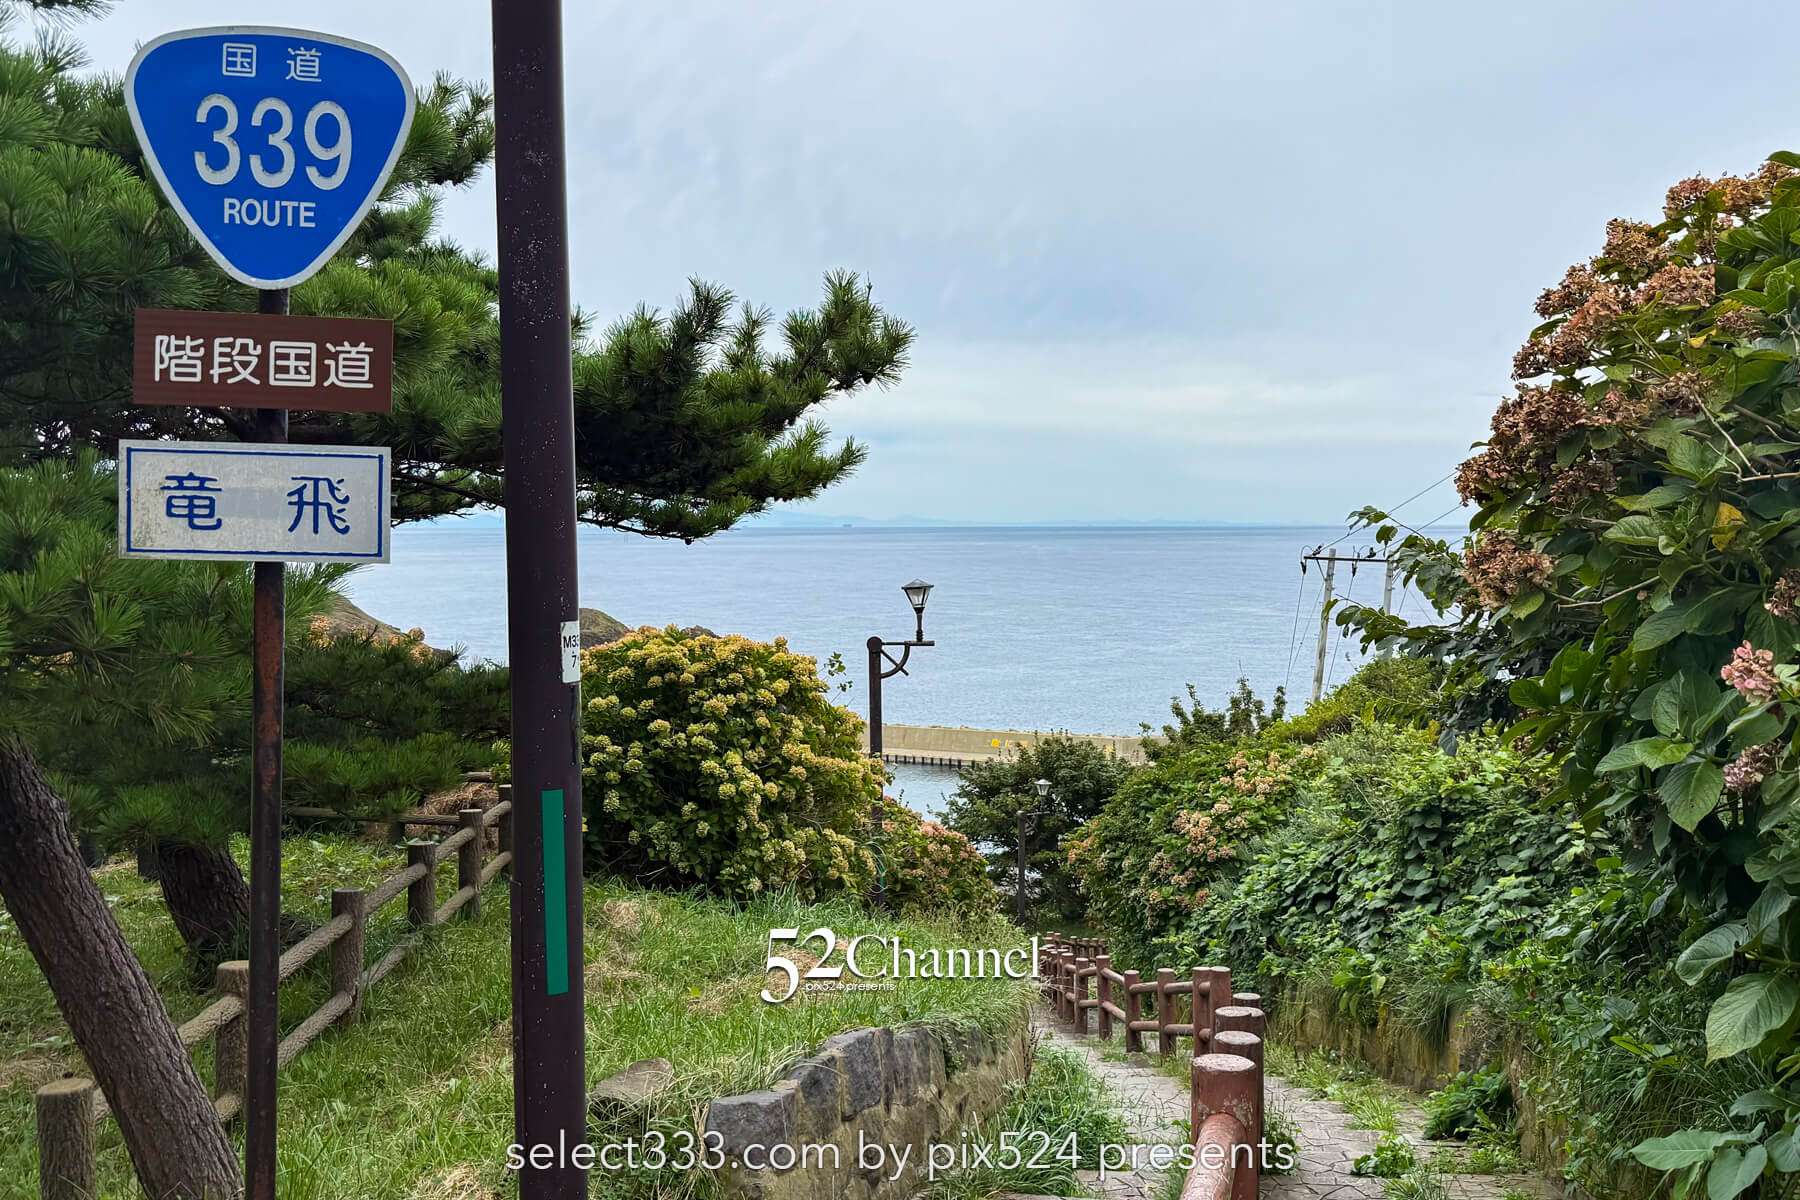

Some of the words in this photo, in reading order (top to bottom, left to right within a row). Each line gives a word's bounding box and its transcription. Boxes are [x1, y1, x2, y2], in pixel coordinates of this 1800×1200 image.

[222, 42, 322, 82] 国道
[194, 93, 352, 190] 339
[223, 198, 316, 228] ROUTE
[154, 334, 374, 389] 階段国道
[160, 472, 350, 534] 竜飛
